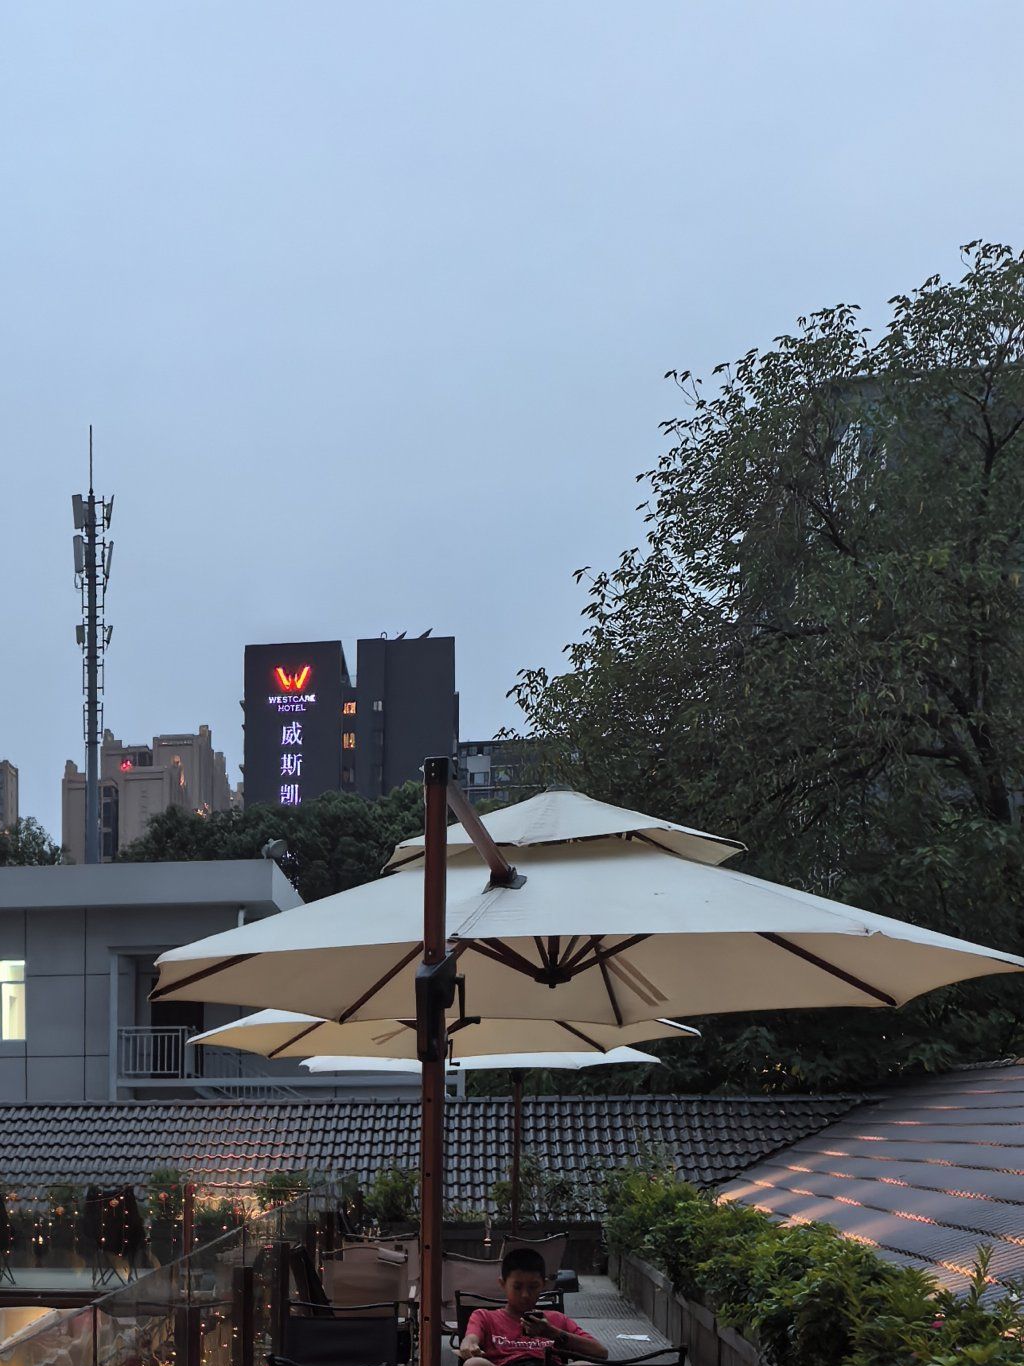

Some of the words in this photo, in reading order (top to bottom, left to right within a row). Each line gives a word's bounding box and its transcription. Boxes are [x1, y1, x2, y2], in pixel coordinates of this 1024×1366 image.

[277, 704, 307, 712] HOTEL
[280, 721, 303, 806] 威斯凯
